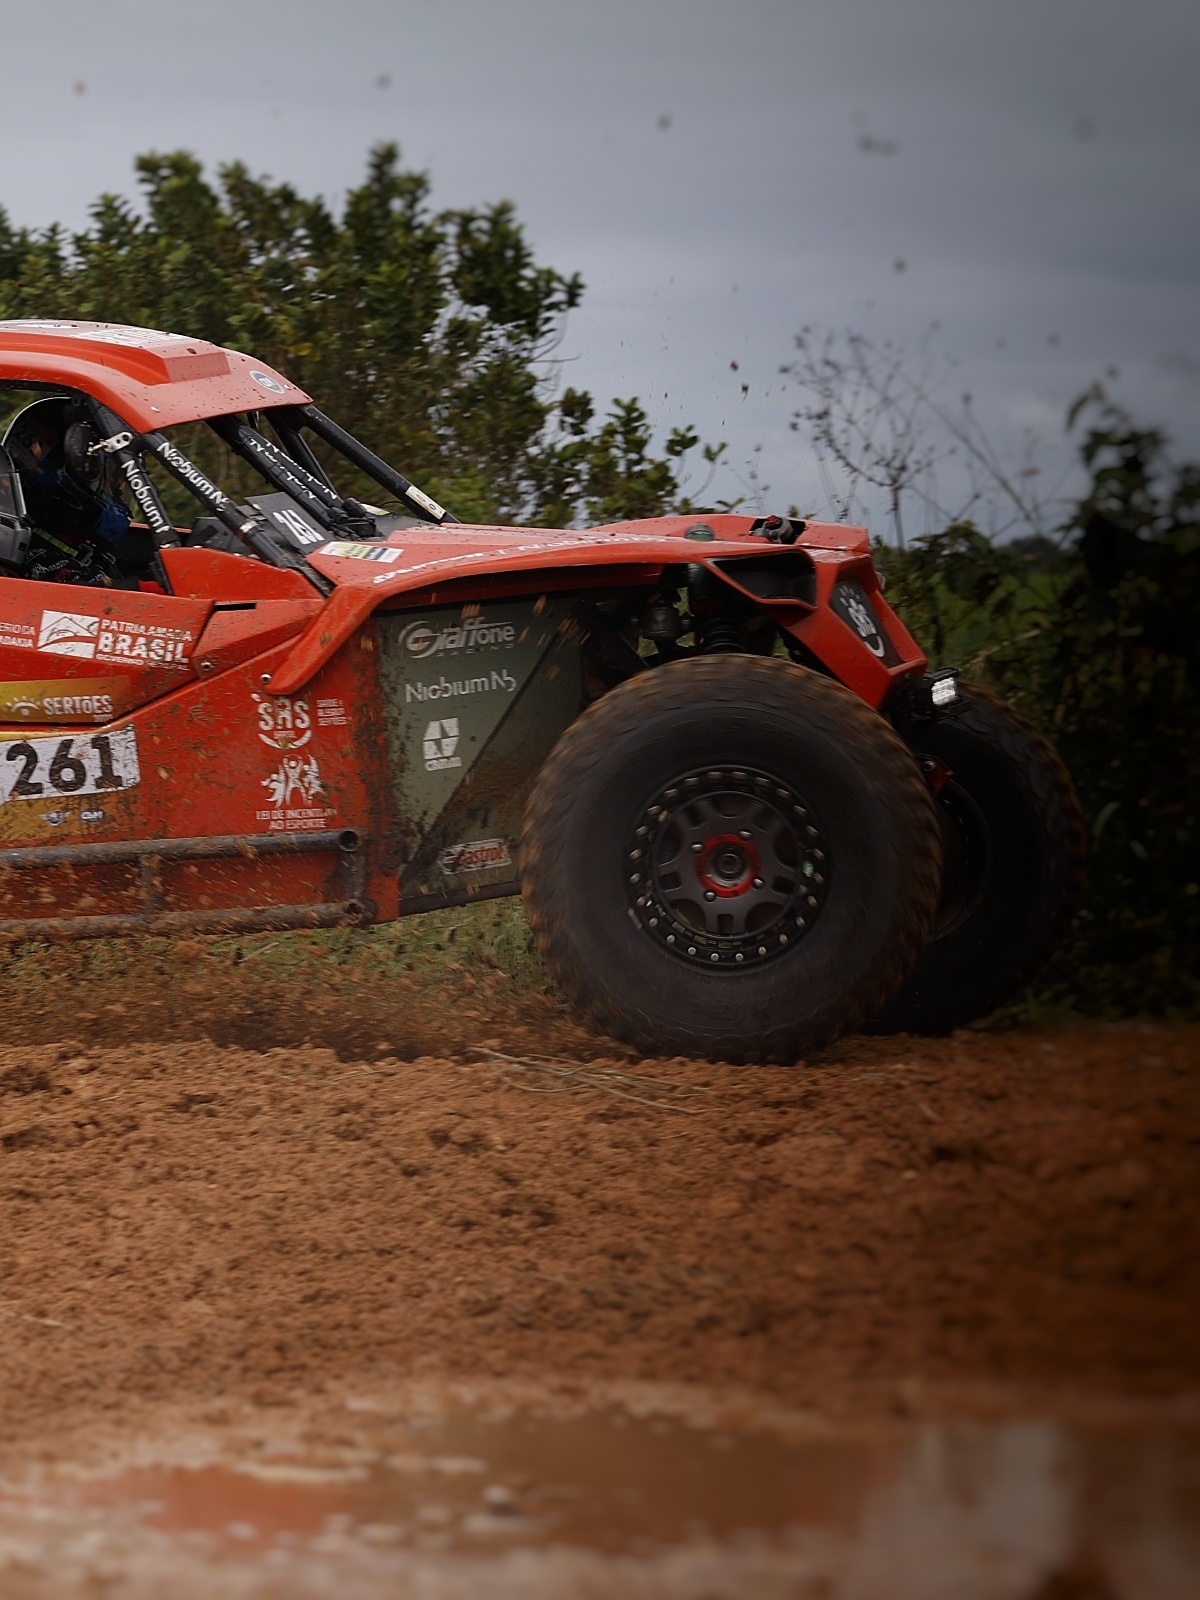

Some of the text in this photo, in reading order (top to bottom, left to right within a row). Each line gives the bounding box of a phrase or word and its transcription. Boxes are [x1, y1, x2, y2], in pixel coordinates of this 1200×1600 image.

[121, 460, 164, 527] Niobium
[156, 442, 214, 495] Niobium
[98, 631, 189, 664] BRASIL
[405, 676, 489, 703] Niobium
[6, 736, 122, 797] 261
